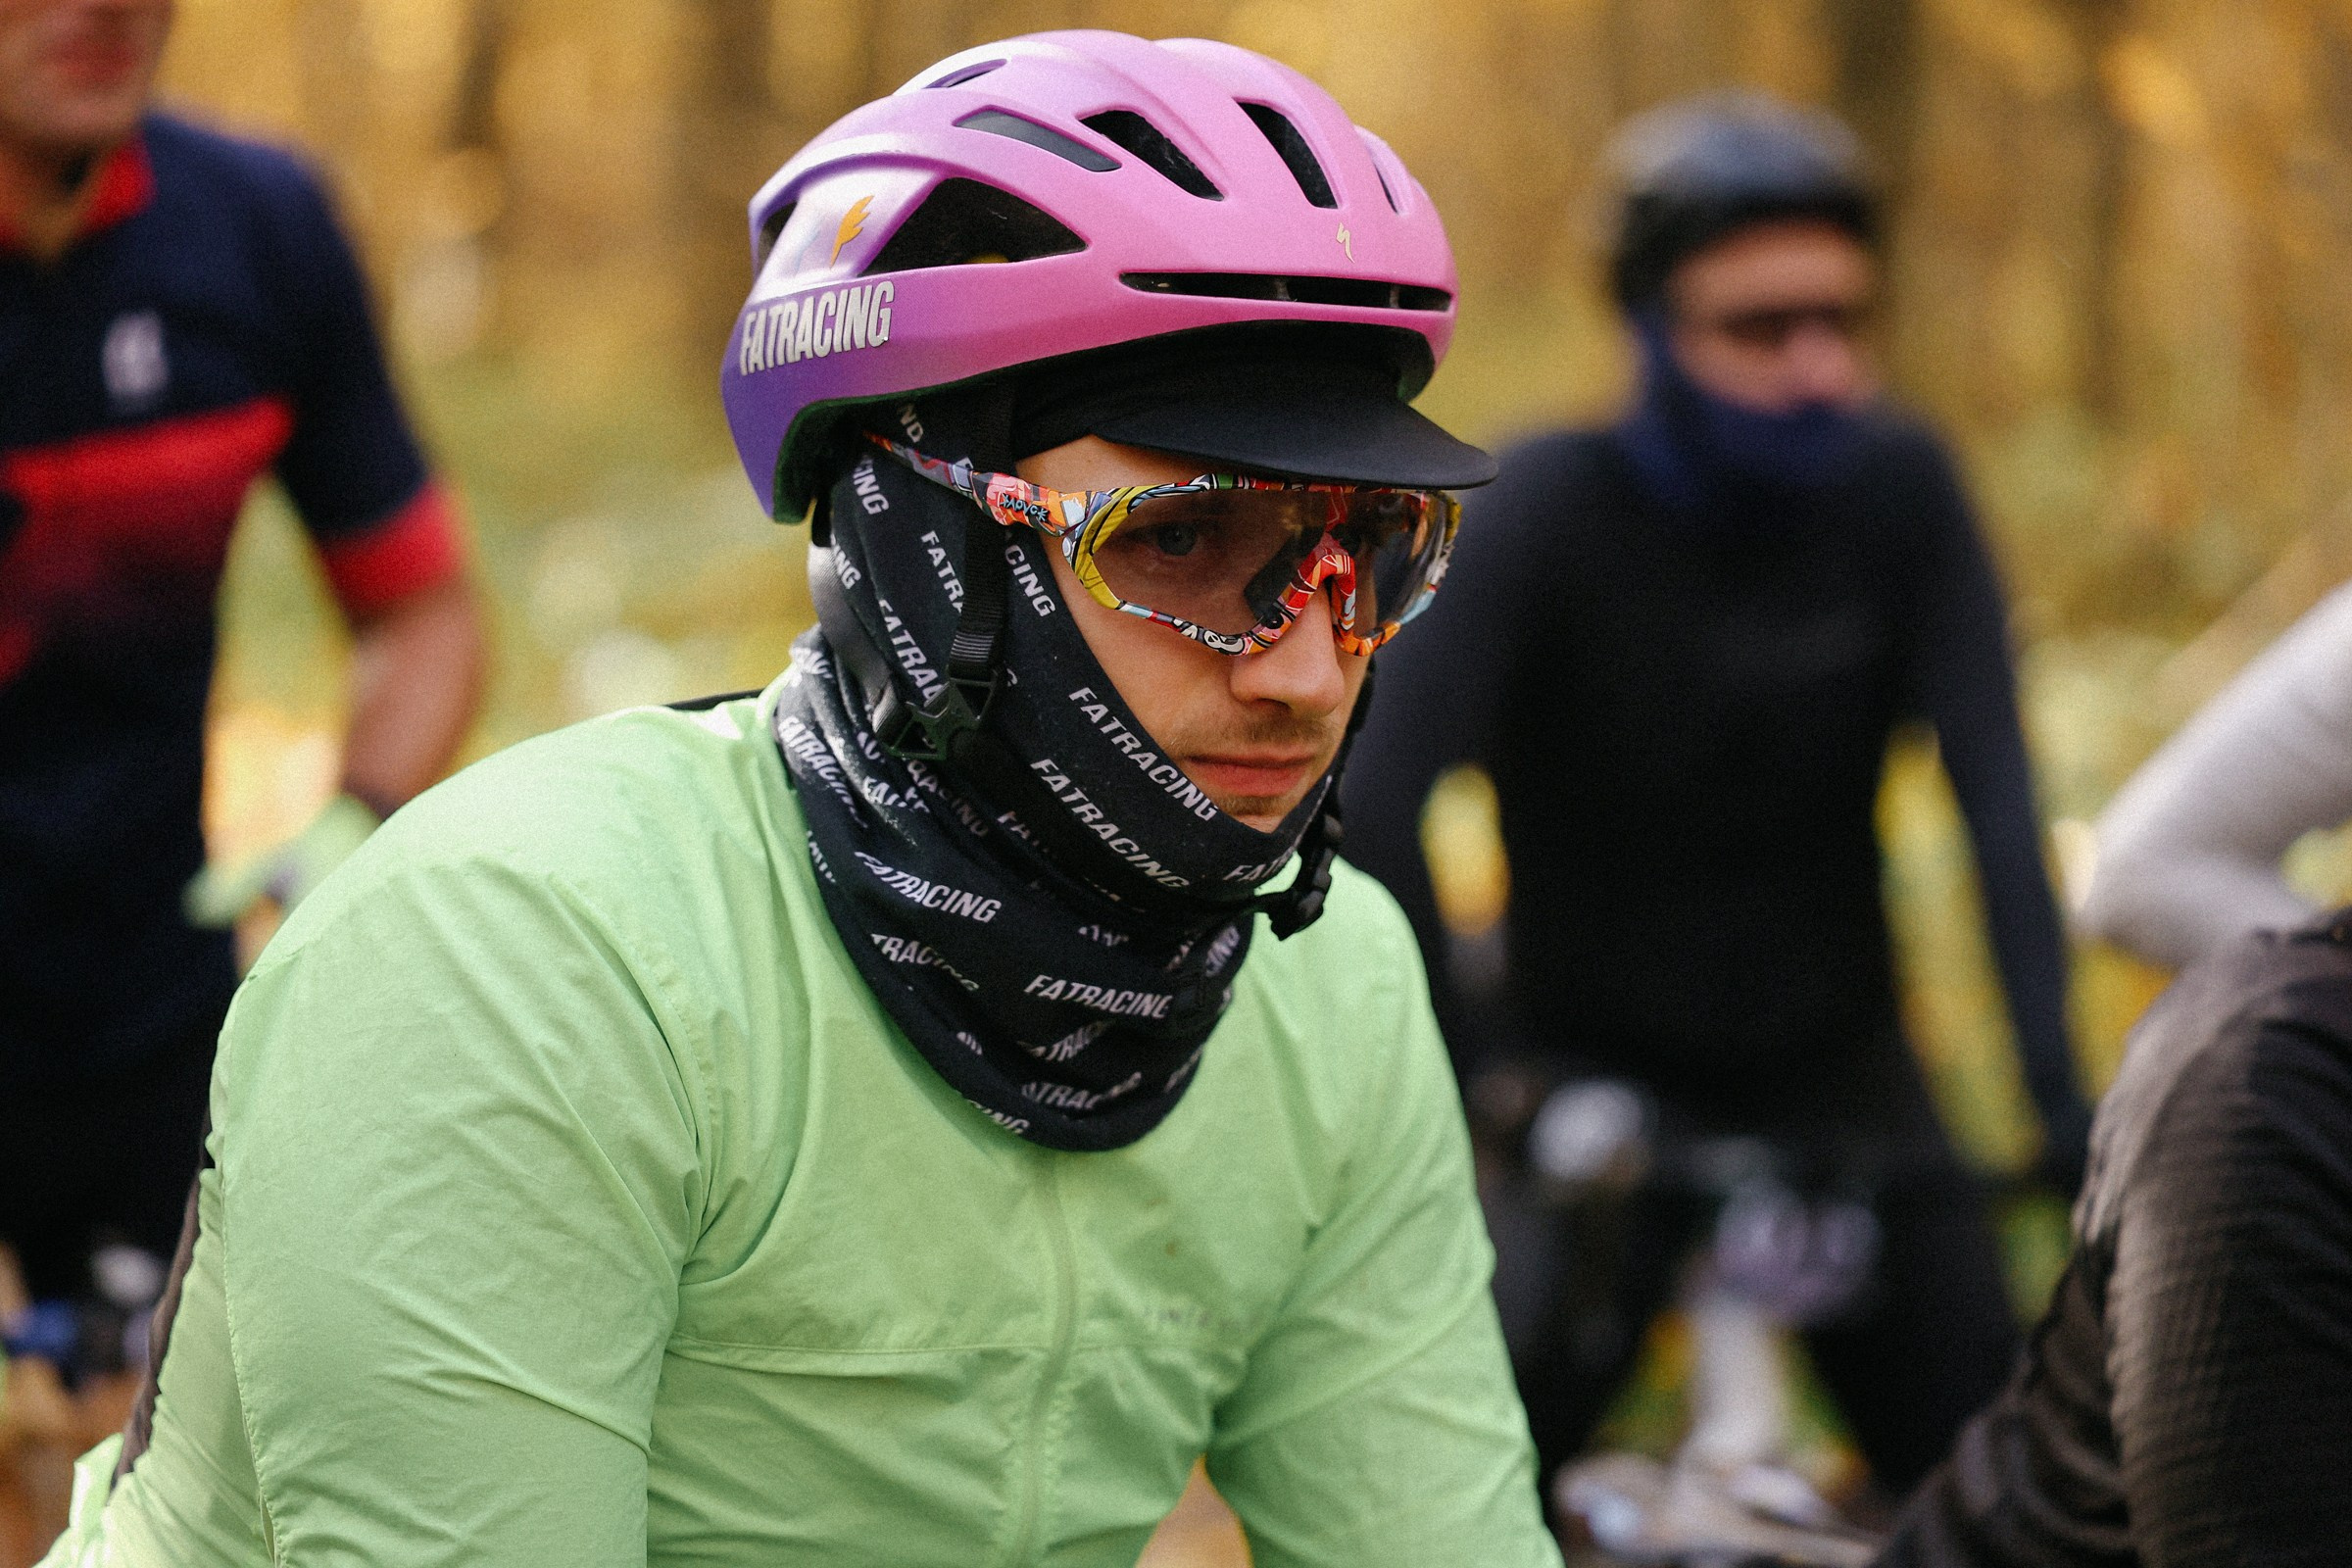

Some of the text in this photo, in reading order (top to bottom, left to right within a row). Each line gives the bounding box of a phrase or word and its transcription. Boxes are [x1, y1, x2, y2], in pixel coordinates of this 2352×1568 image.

[740, 280, 894, 376] FATRACING
[1068, 687, 1220, 822] FATRACING
[1030, 758, 1190, 889] FATRACING
[854, 850, 1003, 924] FATRACING
